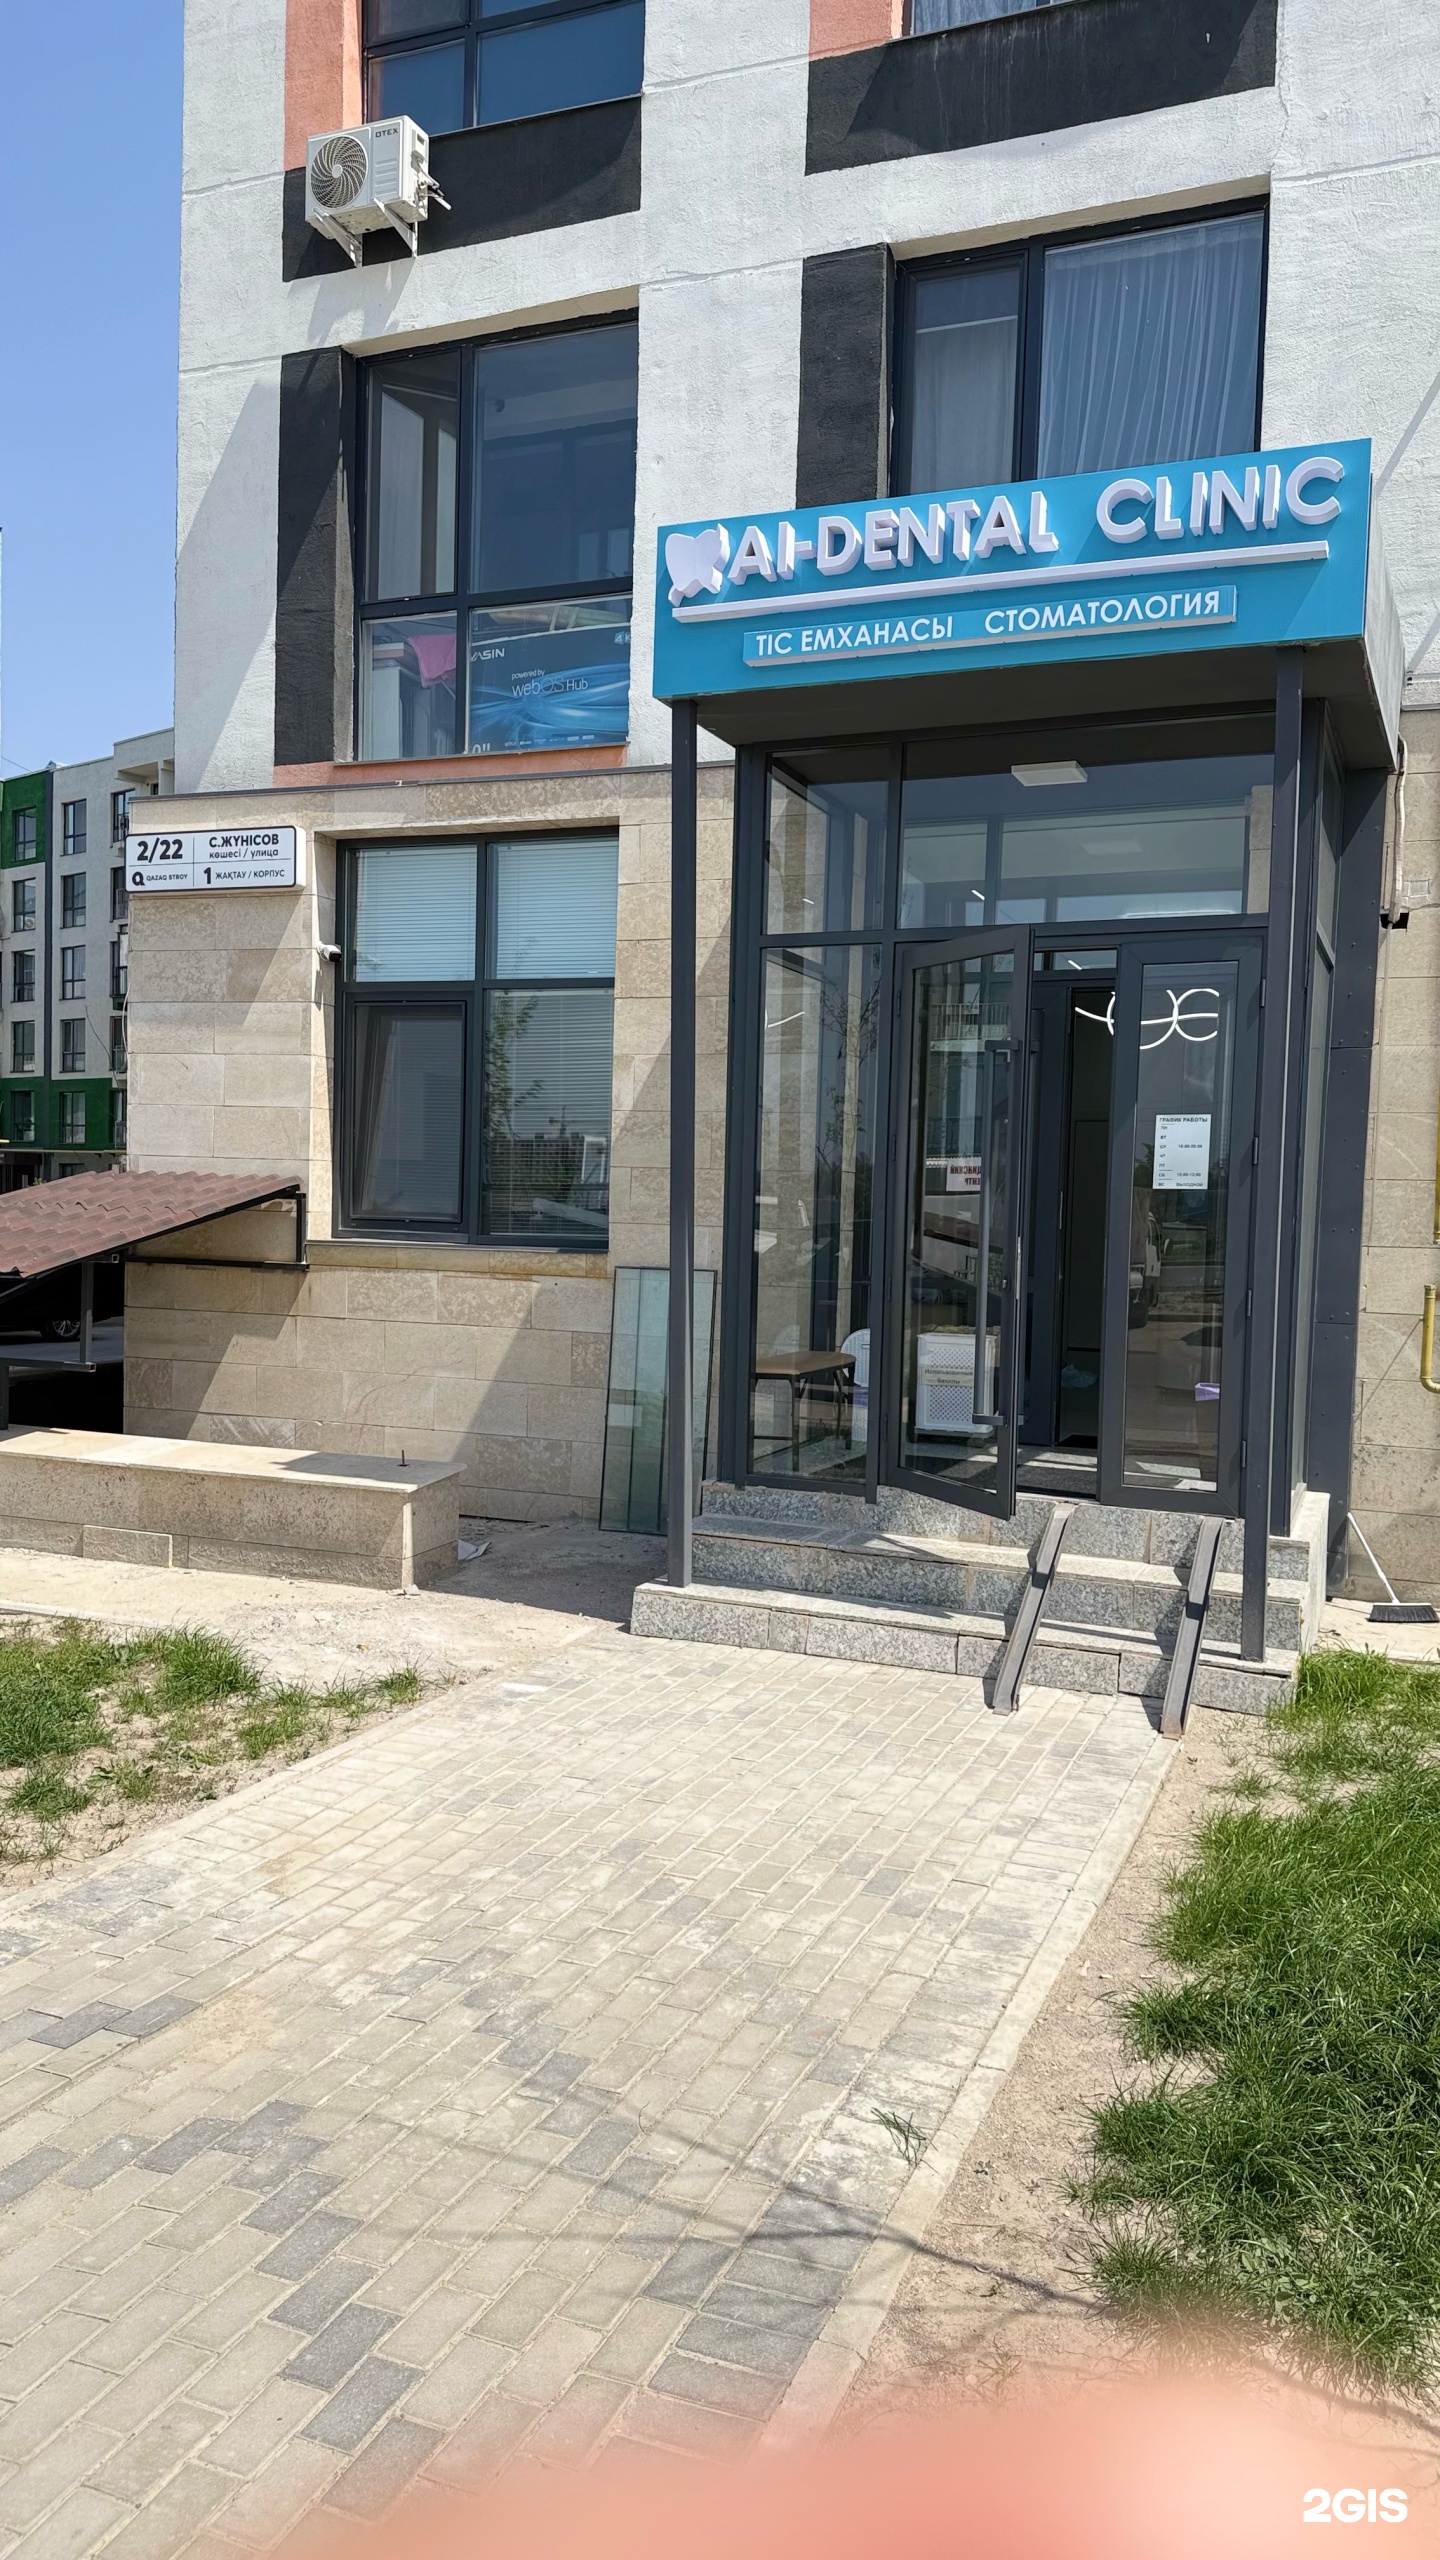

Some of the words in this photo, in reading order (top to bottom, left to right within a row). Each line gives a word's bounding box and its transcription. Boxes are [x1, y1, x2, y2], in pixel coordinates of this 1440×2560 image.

[375, 127, 398, 138] OTEX
[727, 490, 1060, 586] AI-DENTAL
[1095, 456, 1345, 544] CLINIC
[756, 632, 793, 657] ТІС
[801, 616, 953, 652] ЕМХАНАСЫ
[984, 590, 1220, 634] СТОМАТОЛОГИЯ
[512, 669, 536, 680] powered
[537, 668, 546, 677] by
[512, 677, 564, 696] webOS
[566, 678, 588, 691] Hub
[137, 837, 183, 863] 2/22
[209, 849, 242, 859] көшесі
[250, 849, 279, 859] улица
[168, 873, 188, 881] STROY
[203, 867, 212, 885] 1
[215, 871, 247, 880] ЖАҚТАУ
[253, 869, 285, 878] КОРПУС
